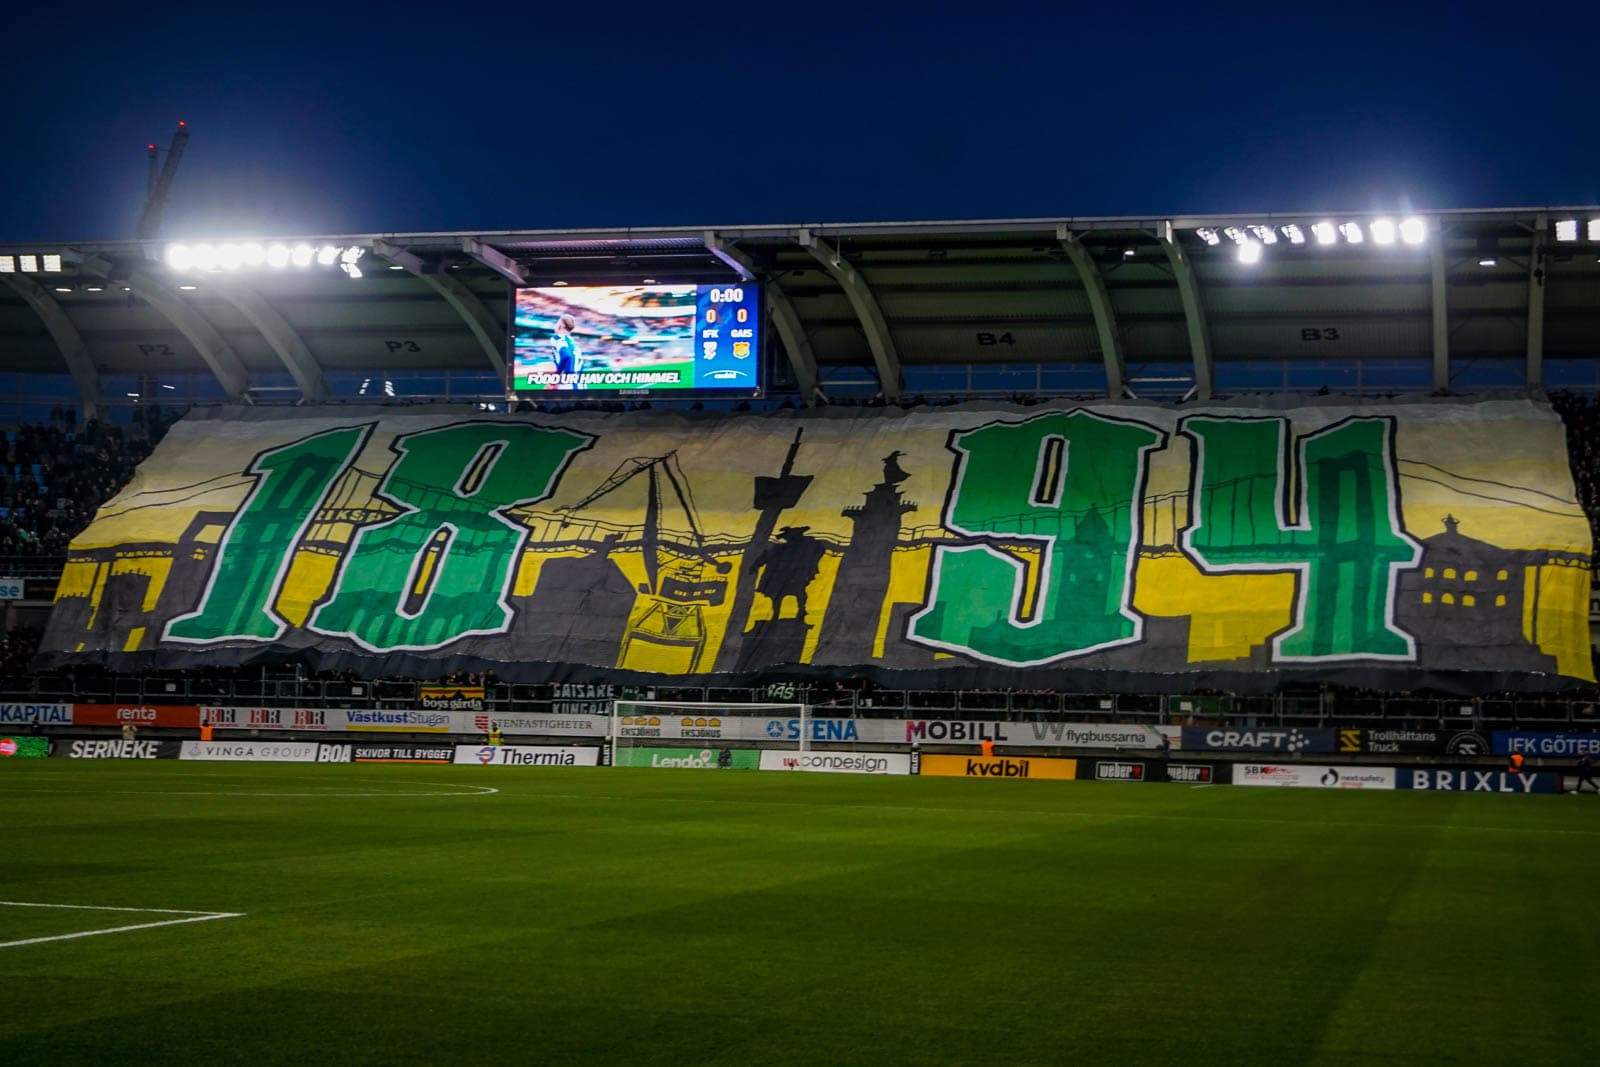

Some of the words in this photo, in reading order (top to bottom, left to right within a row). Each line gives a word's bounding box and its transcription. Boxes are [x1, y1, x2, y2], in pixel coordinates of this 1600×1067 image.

[710, 288, 744, 303] 0:00
[706, 309, 717, 323] 0
[737, 309, 748, 323] 0
[702, 329, 719, 338] IFK
[730, 329, 753, 338] GAIS
[976, 332, 1016, 345] B4
[1301, 328, 1340, 341] B3
[385, 340, 421, 353] P3
[632, 373, 681, 384] HIMMEL
[162, 420, 599, 652] 18
[906, 407, 1426, 667] 94
[0, 705, 72, 722] KAPITAL
[116, 708, 157, 721] renta
[787, 719, 858, 741] STENA
[906, 720, 1007, 742] MOBILL
[1066, 730, 1146, 744] flygbussarna
[1367, 730, 1437, 742] Trollhättans
[1206, 731, 1287, 749] CRAFT
[1507, 737, 1537, 752] IFK
[69, 740, 162, 760] SERNEKE
[206, 746, 255, 757] VINGA
[260, 747, 313, 758] GROUP
[317, 744, 352, 763] BOA
[354, 748, 391, 759] SKIVOR
[392, 749, 413, 759] TILL
[414, 749, 454, 760] BYGGET
[1367, 742, 1400, 753] Truck
[501, 748, 576, 766] Thermia
[966, 759, 1030, 778] kvdbil
[1099, 763, 1133, 779] weber
[1412, 768, 1538, 793] BRIXLY
